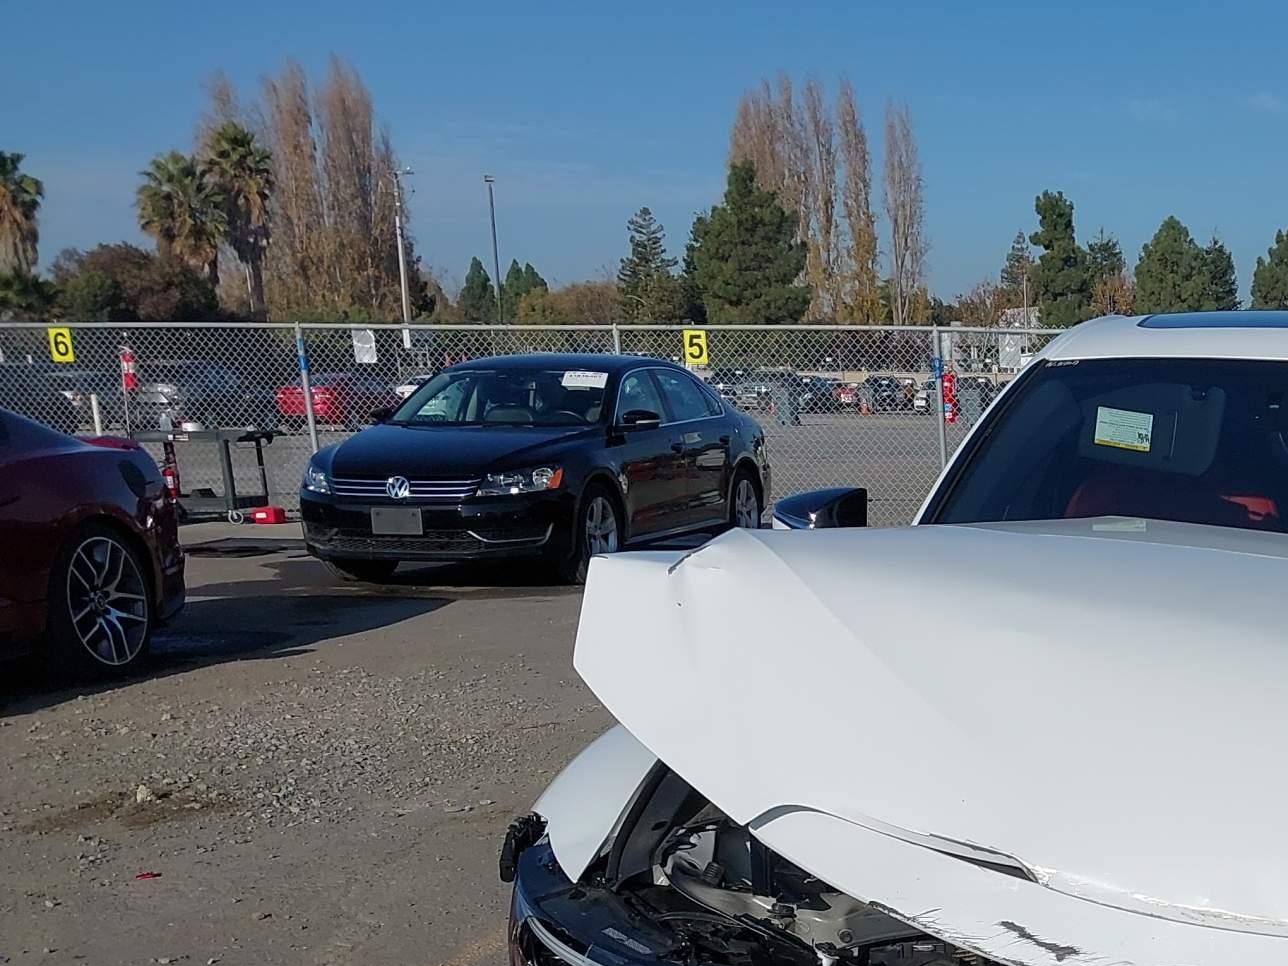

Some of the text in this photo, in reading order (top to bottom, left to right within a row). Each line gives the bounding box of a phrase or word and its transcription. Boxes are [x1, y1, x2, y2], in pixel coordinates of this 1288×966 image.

[54, 332, 69, 357] 6
[688, 334, 704, 359] 5
[386, 475, 410, 499] VW
